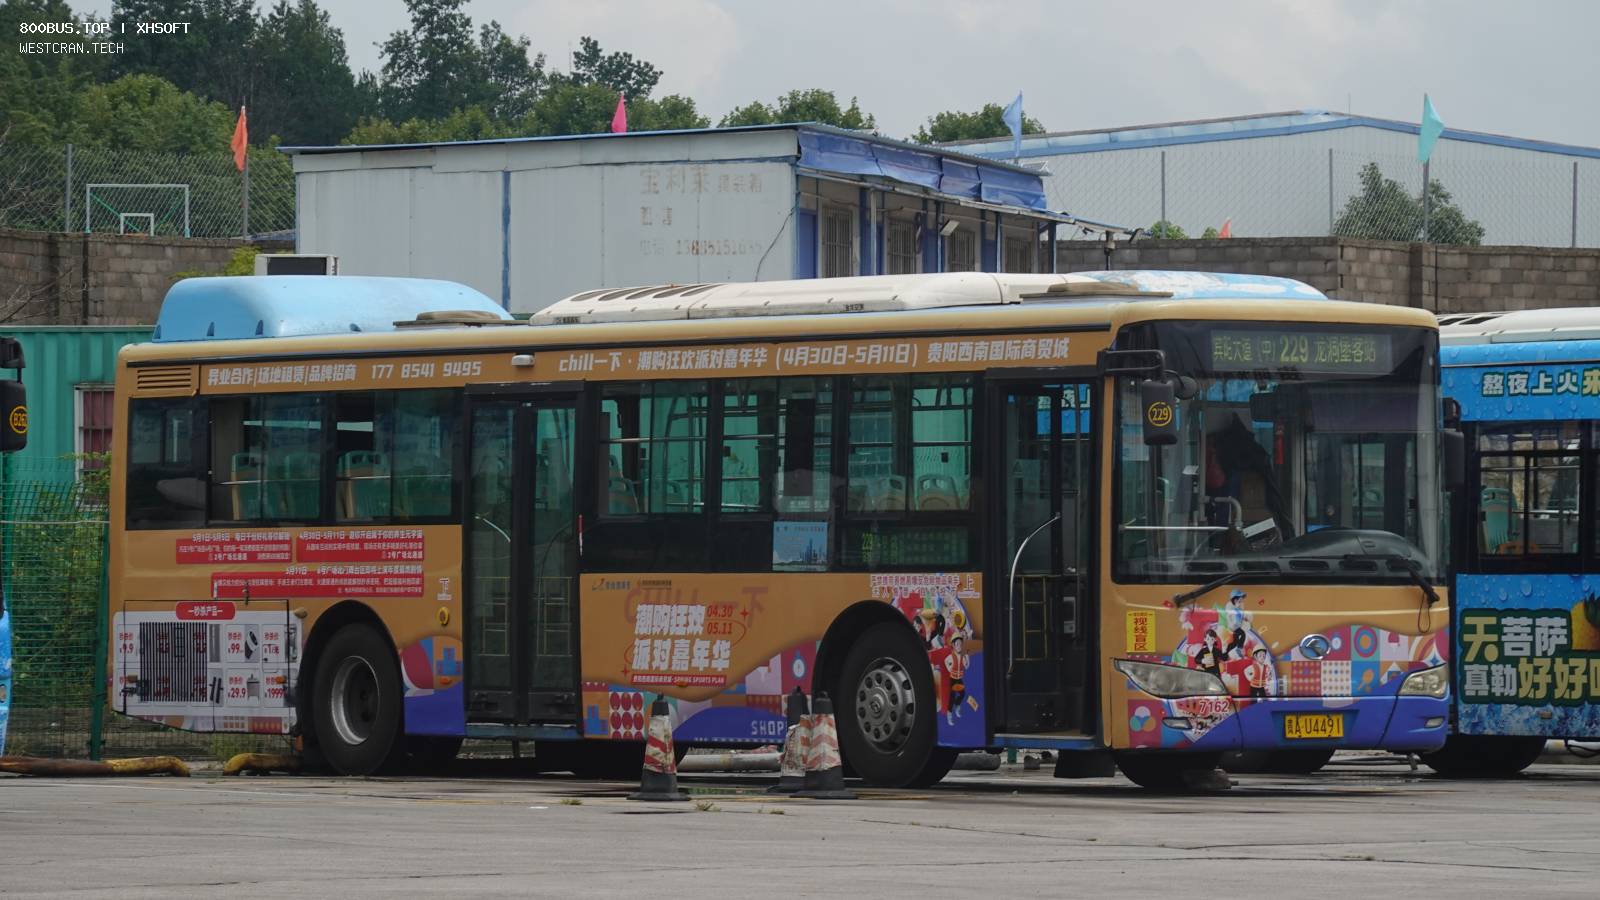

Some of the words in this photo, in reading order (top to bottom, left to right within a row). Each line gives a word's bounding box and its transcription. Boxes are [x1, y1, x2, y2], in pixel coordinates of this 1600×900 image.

[637, 348, 768, 370] 潮购狂欢派对嘉年华
[927, 337, 1070, 363] 贵阳西南国际商贸城
[1280, 335, 1310, 363] 229
[371, 364, 394, 379] 177
[401, 363, 435, 378] 8541
[442, 361, 482, 376] 9495
[1152, 407, 1169, 421] 229
[635, 604, 706, 635] 潮购狂欢
[707, 605, 734, 618] 04.30
[707, 622, 733, 635] 05.11
[1132, 615, 1148, 651] 视线盲区
[1463, 616, 1568, 662] 天菩萨
[631, 639, 731, 671] 派对嘉年华
[1199, 701, 1229, 713] 7162
